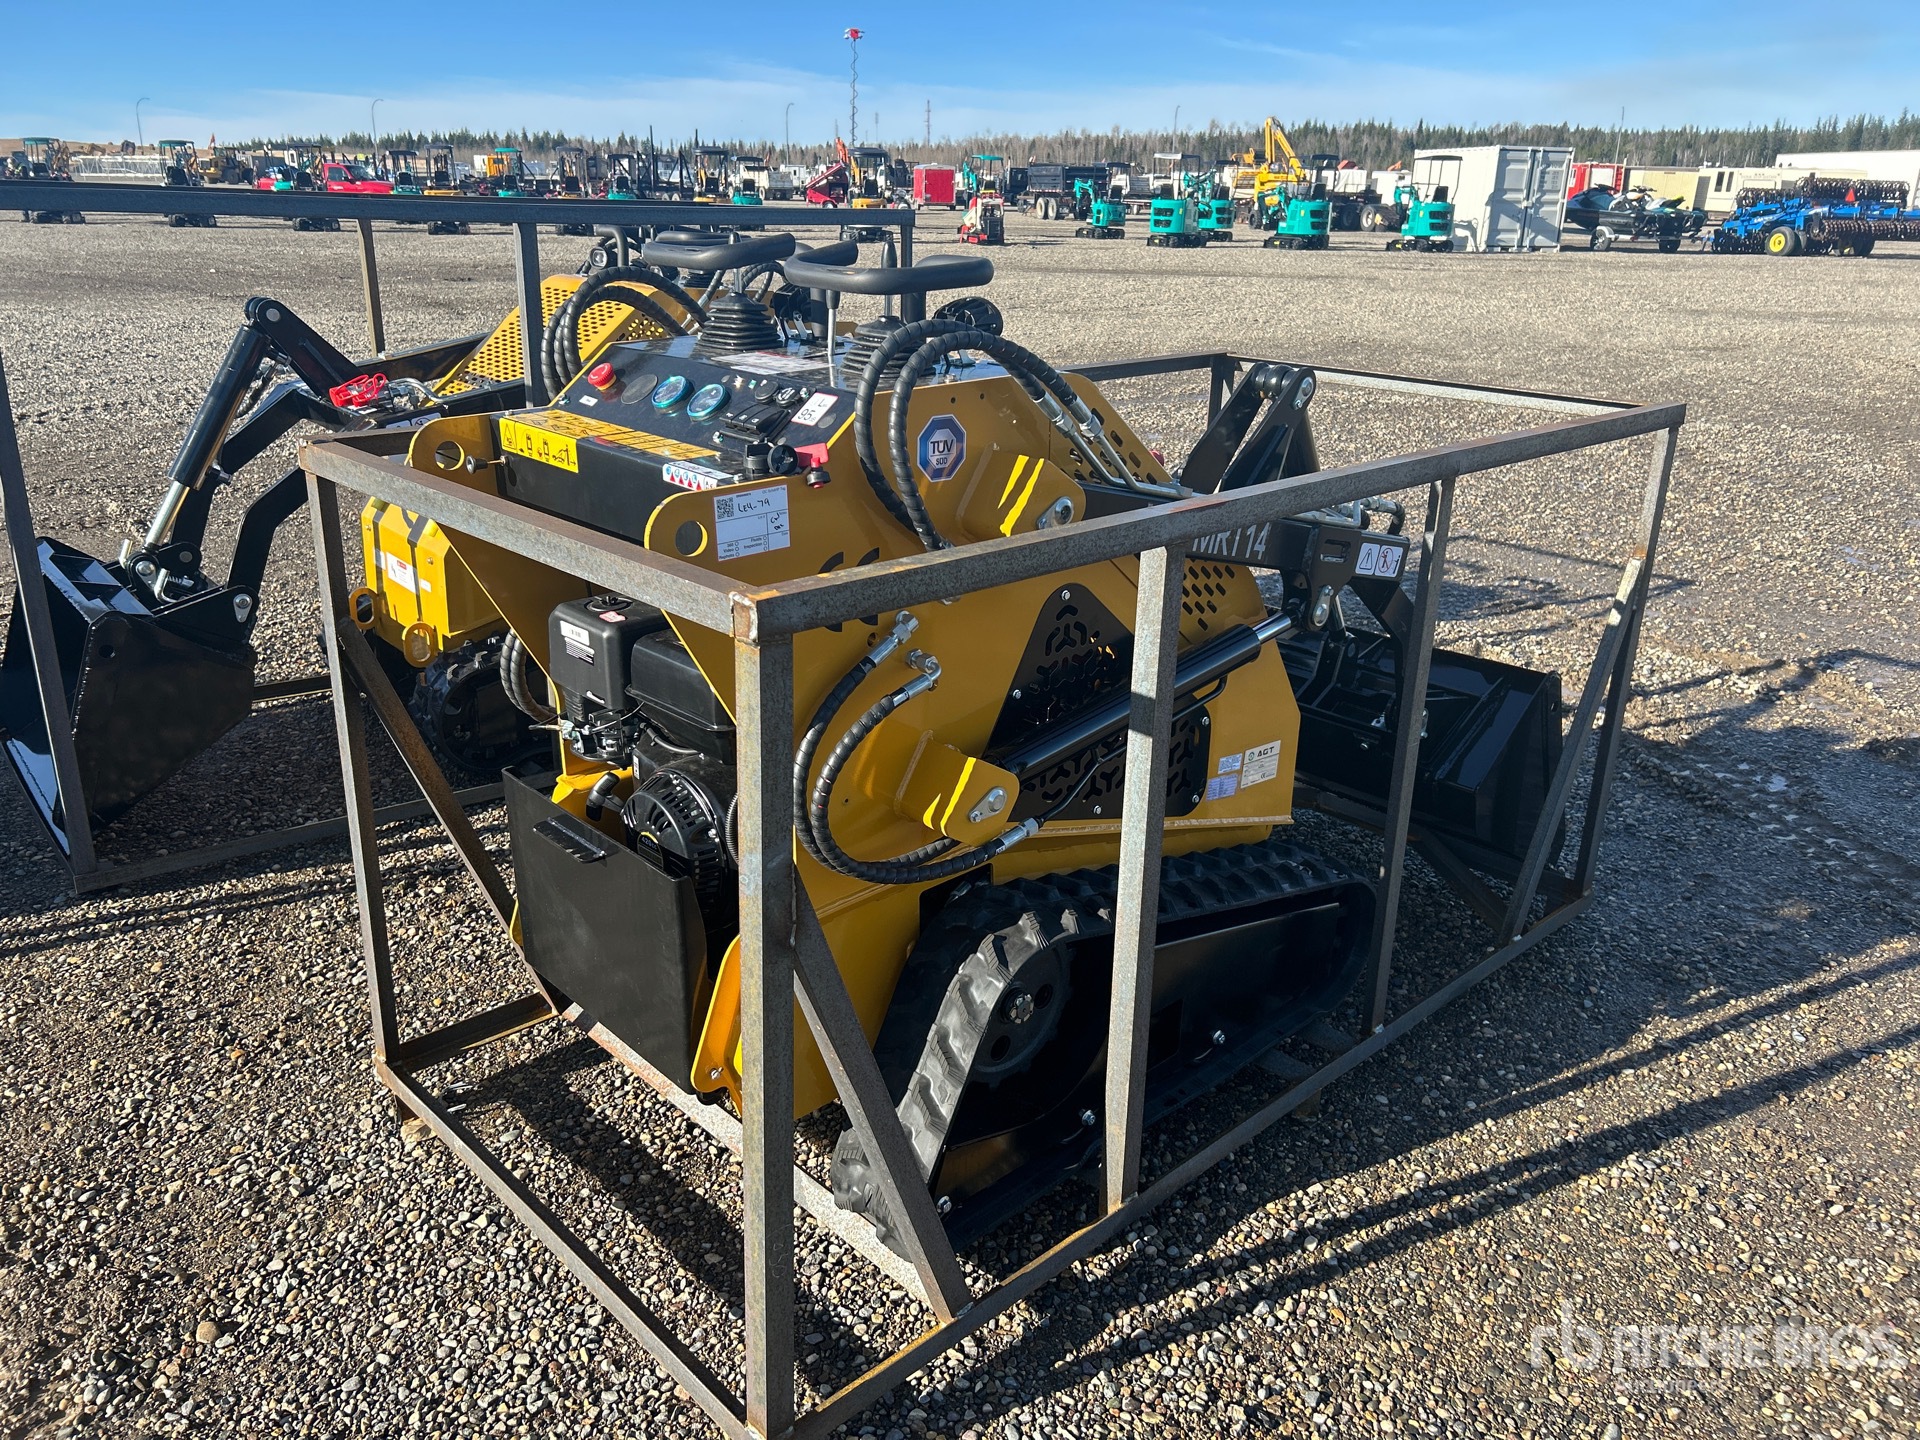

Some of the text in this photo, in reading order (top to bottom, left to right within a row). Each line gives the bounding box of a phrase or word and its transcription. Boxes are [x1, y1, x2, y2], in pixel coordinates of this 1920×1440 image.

[797, 408, 816, 421] 95
[930, 439, 954, 454] TÜV
[1257, 746, 1275, 757] AGT
